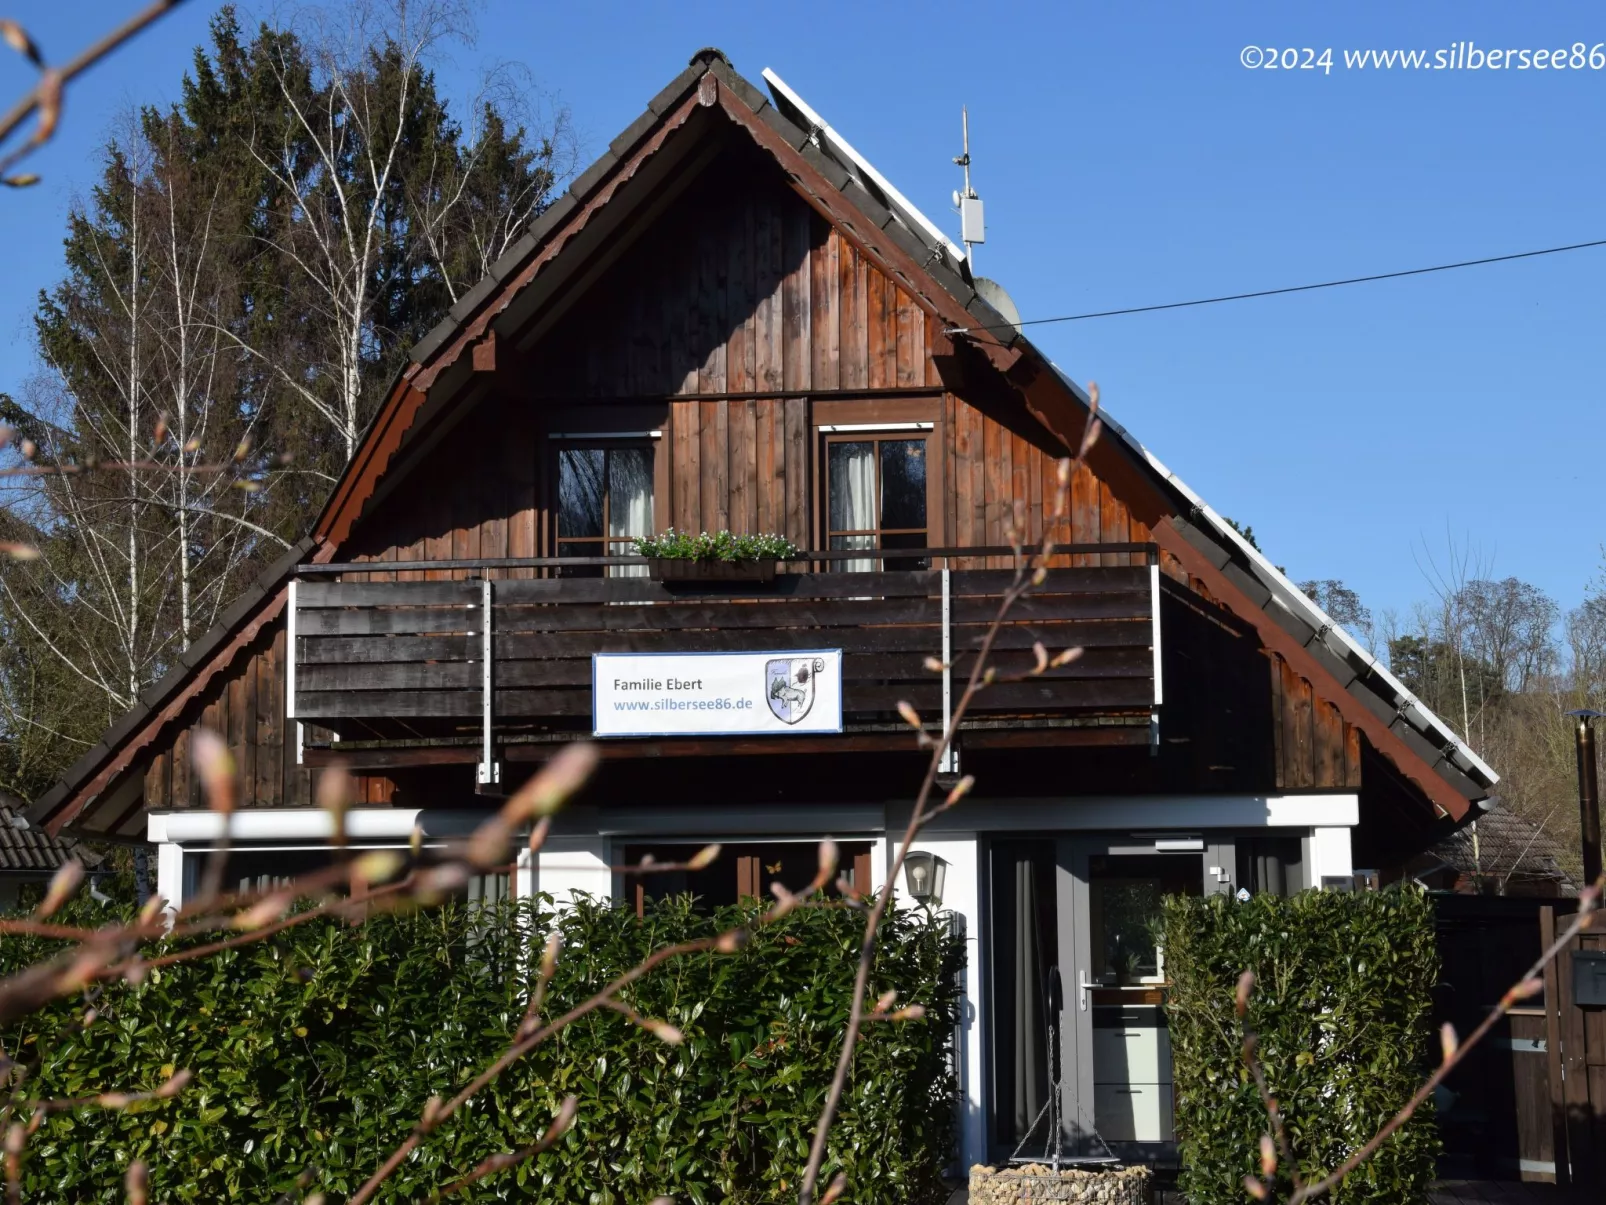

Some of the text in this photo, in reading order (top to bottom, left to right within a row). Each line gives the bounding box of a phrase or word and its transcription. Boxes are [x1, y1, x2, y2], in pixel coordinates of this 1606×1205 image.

[613, 678, 703, 691] Familie Ebert
[613, 697, 753, 711] www.silbersee86.de
